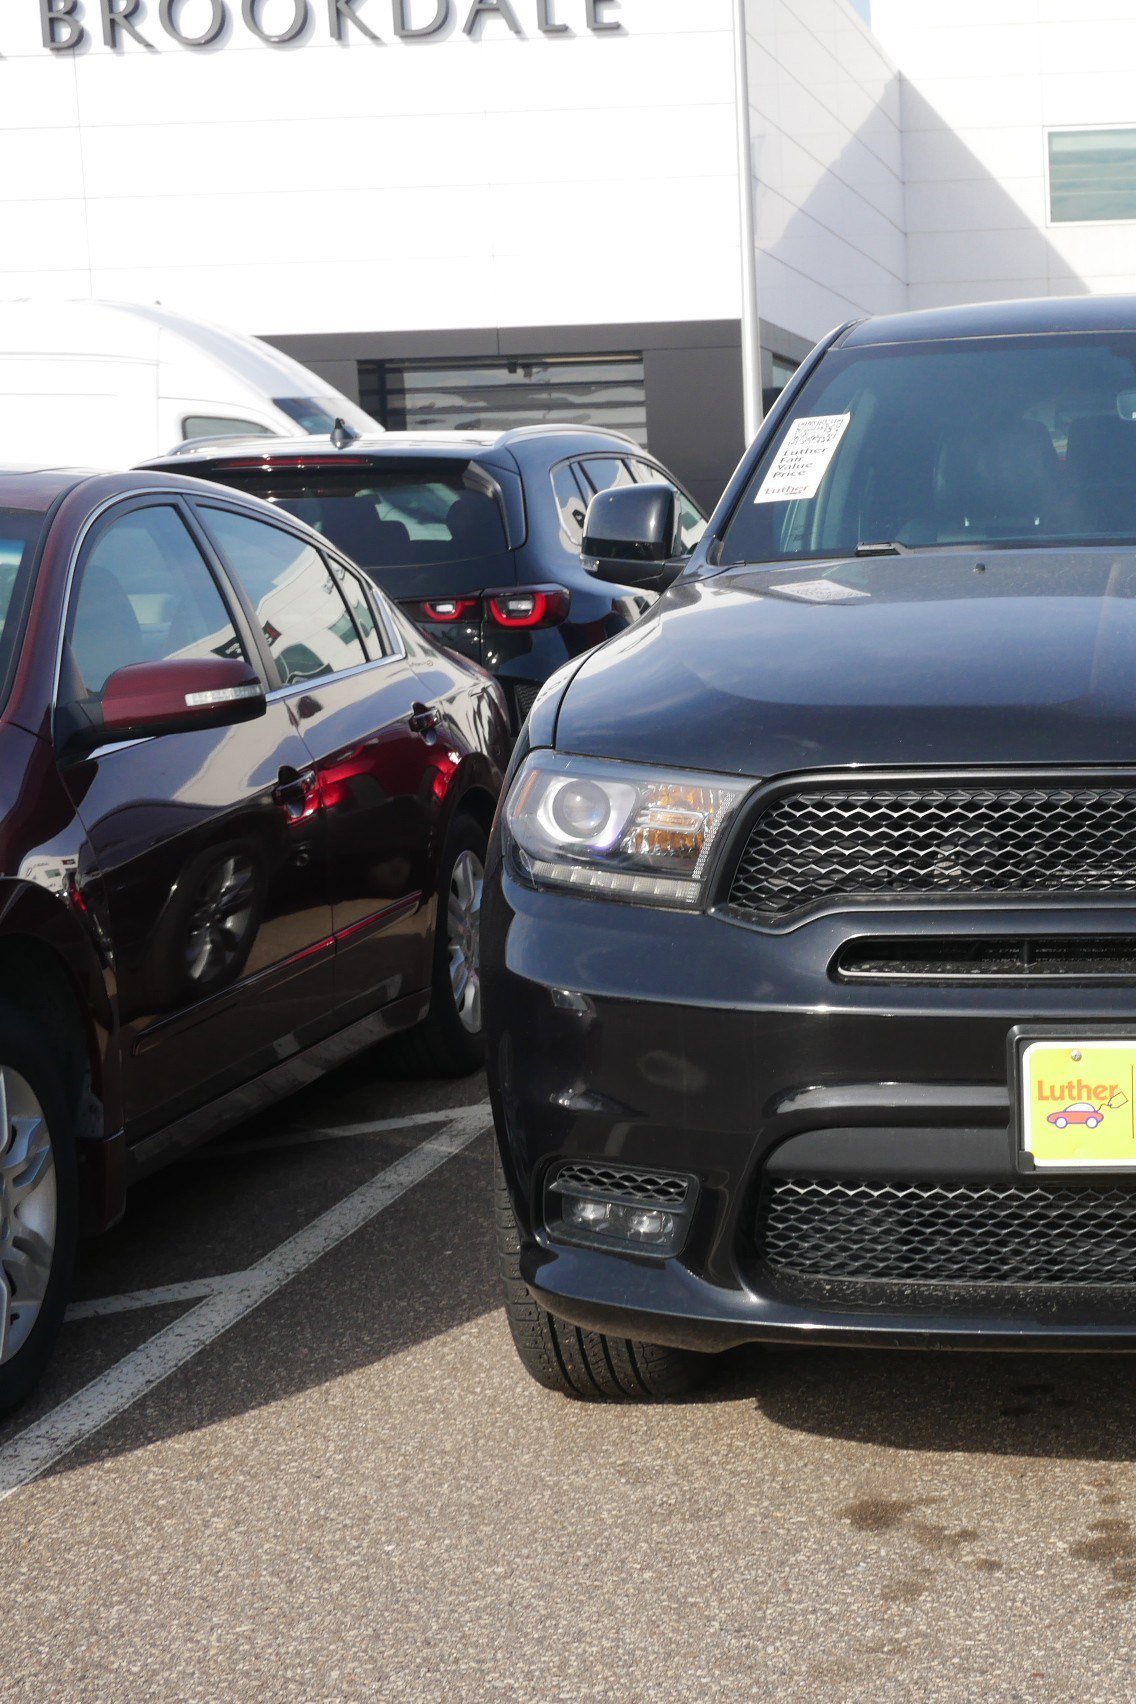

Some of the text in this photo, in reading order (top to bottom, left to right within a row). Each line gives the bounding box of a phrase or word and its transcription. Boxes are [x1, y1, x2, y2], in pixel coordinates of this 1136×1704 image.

[39, 0, 623, 50] BROOKDALE
[783, 447, 828, 456] Luther
[780, 456, 803, 464] Fair
[777, 462, 813, 470] Value
[773, 470, 806, 478] Price
[765, 485, 808, 495] Luther
[1037, 1079, 1118, 1101] Luther
